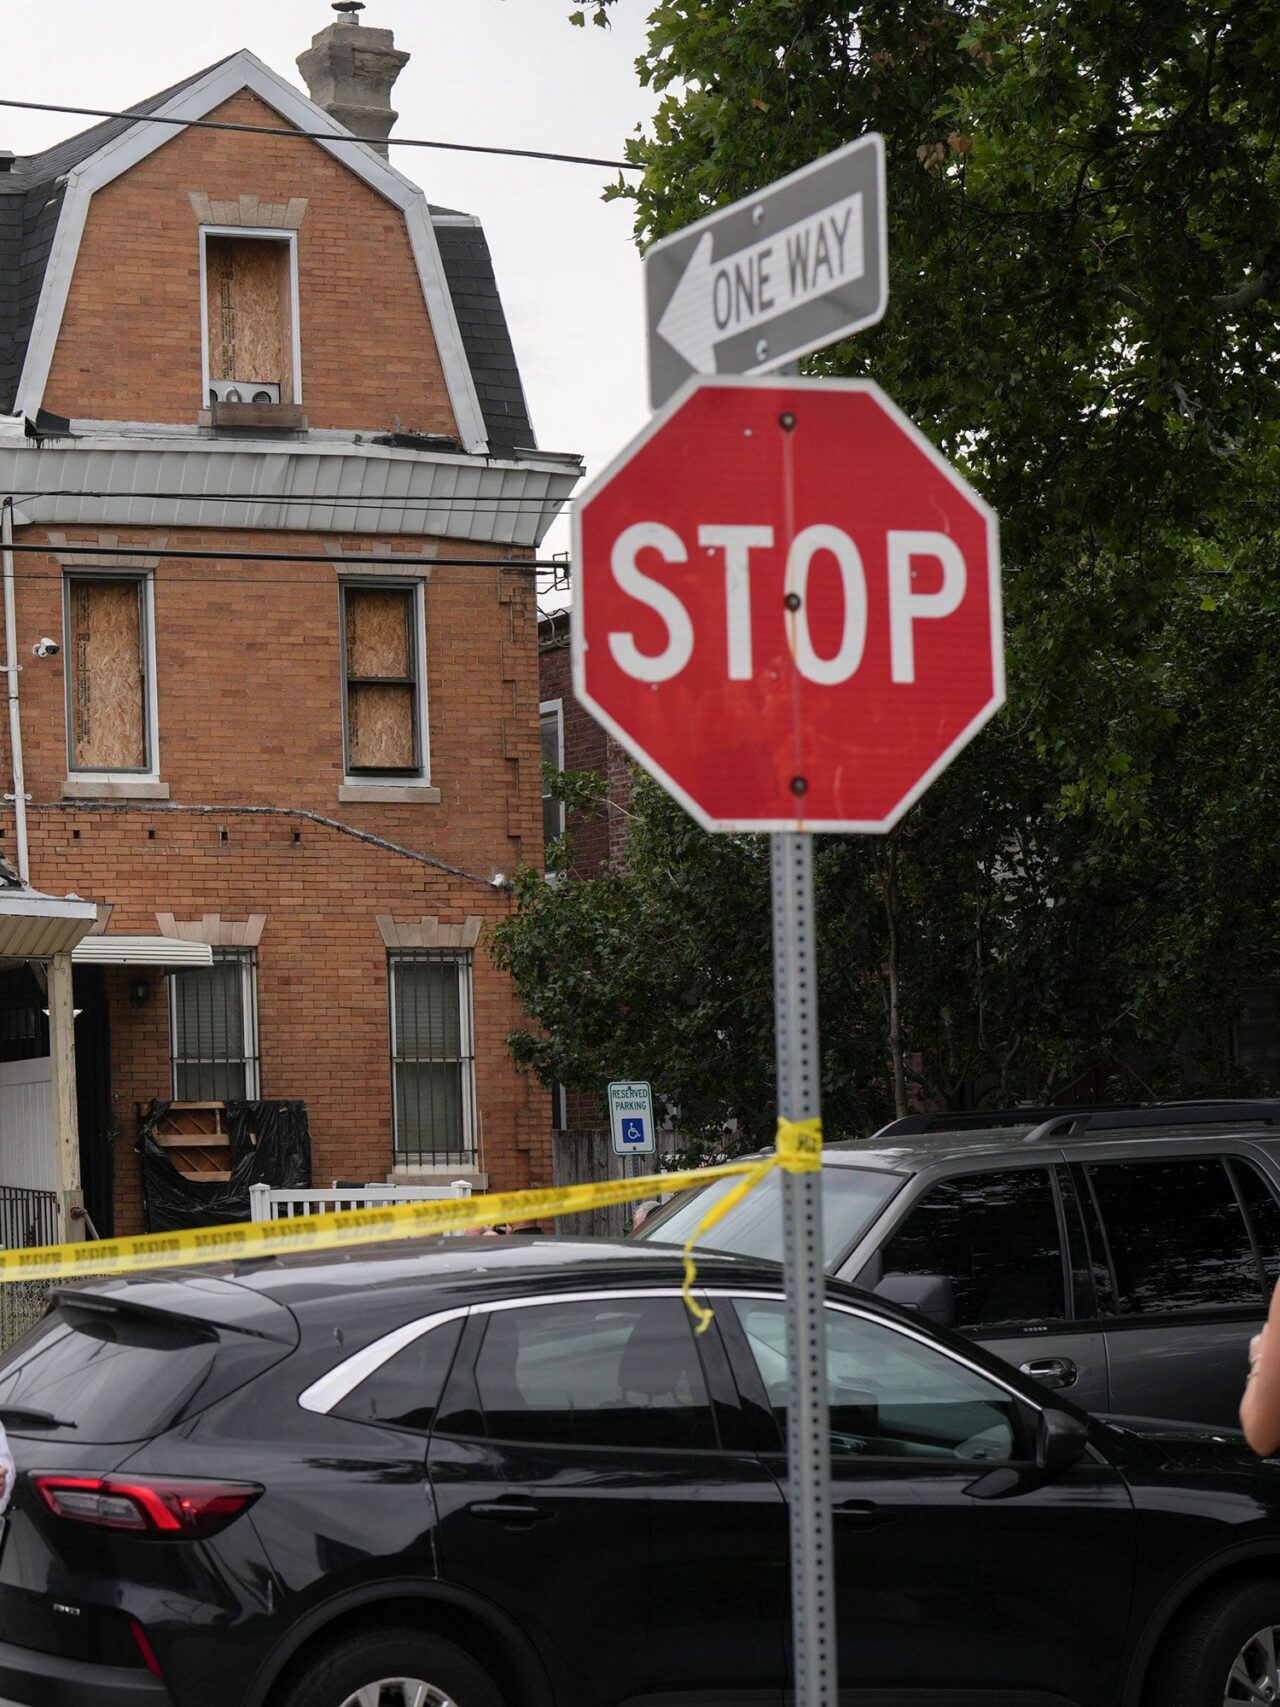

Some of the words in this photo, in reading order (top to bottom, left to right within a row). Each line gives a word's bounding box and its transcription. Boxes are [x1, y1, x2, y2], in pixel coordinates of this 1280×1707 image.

[714, 248, 774, 331] ONE
[787, 207, 852, 297] WAY
[608, 521, 967, 685] STOP
[612, 1089, 648, 1099] RESERVED
[615, 1101, 647, 1111] PARKING
